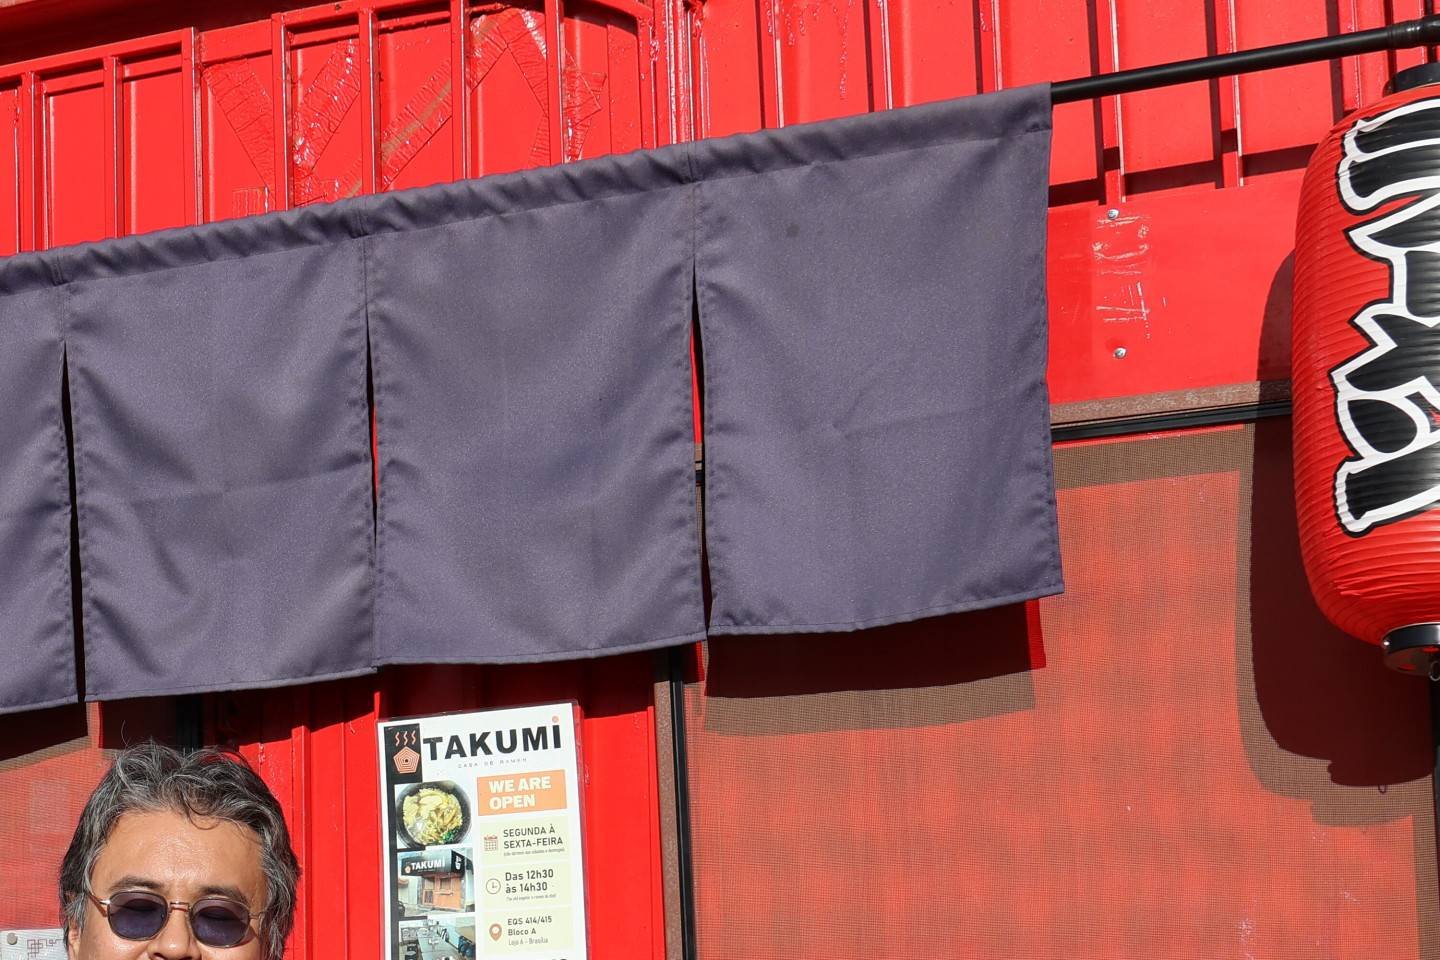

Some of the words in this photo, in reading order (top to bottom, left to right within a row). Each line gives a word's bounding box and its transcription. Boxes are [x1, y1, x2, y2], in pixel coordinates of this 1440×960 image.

[488, 779, 515, 794] WE
[518, 776, 552, 792] ARE
[489, 794, 536, 811] OPEN
[503, 826, 547, 838] SEGUNDA
[503, 836, 564, 849] SEXTA-FEIRA
[505, 872, 524, 881] Das
[526, 868, 554, 880] 12h30
[505, 883, 517, 894] às
[520, 881, 548, 893] 14h30
[507, 918, 524, 926] EQS
[525, 915, 553, 925] 414/415
[507, 928, 529, 936] Bloco
[530, 927, 537, 935] A
